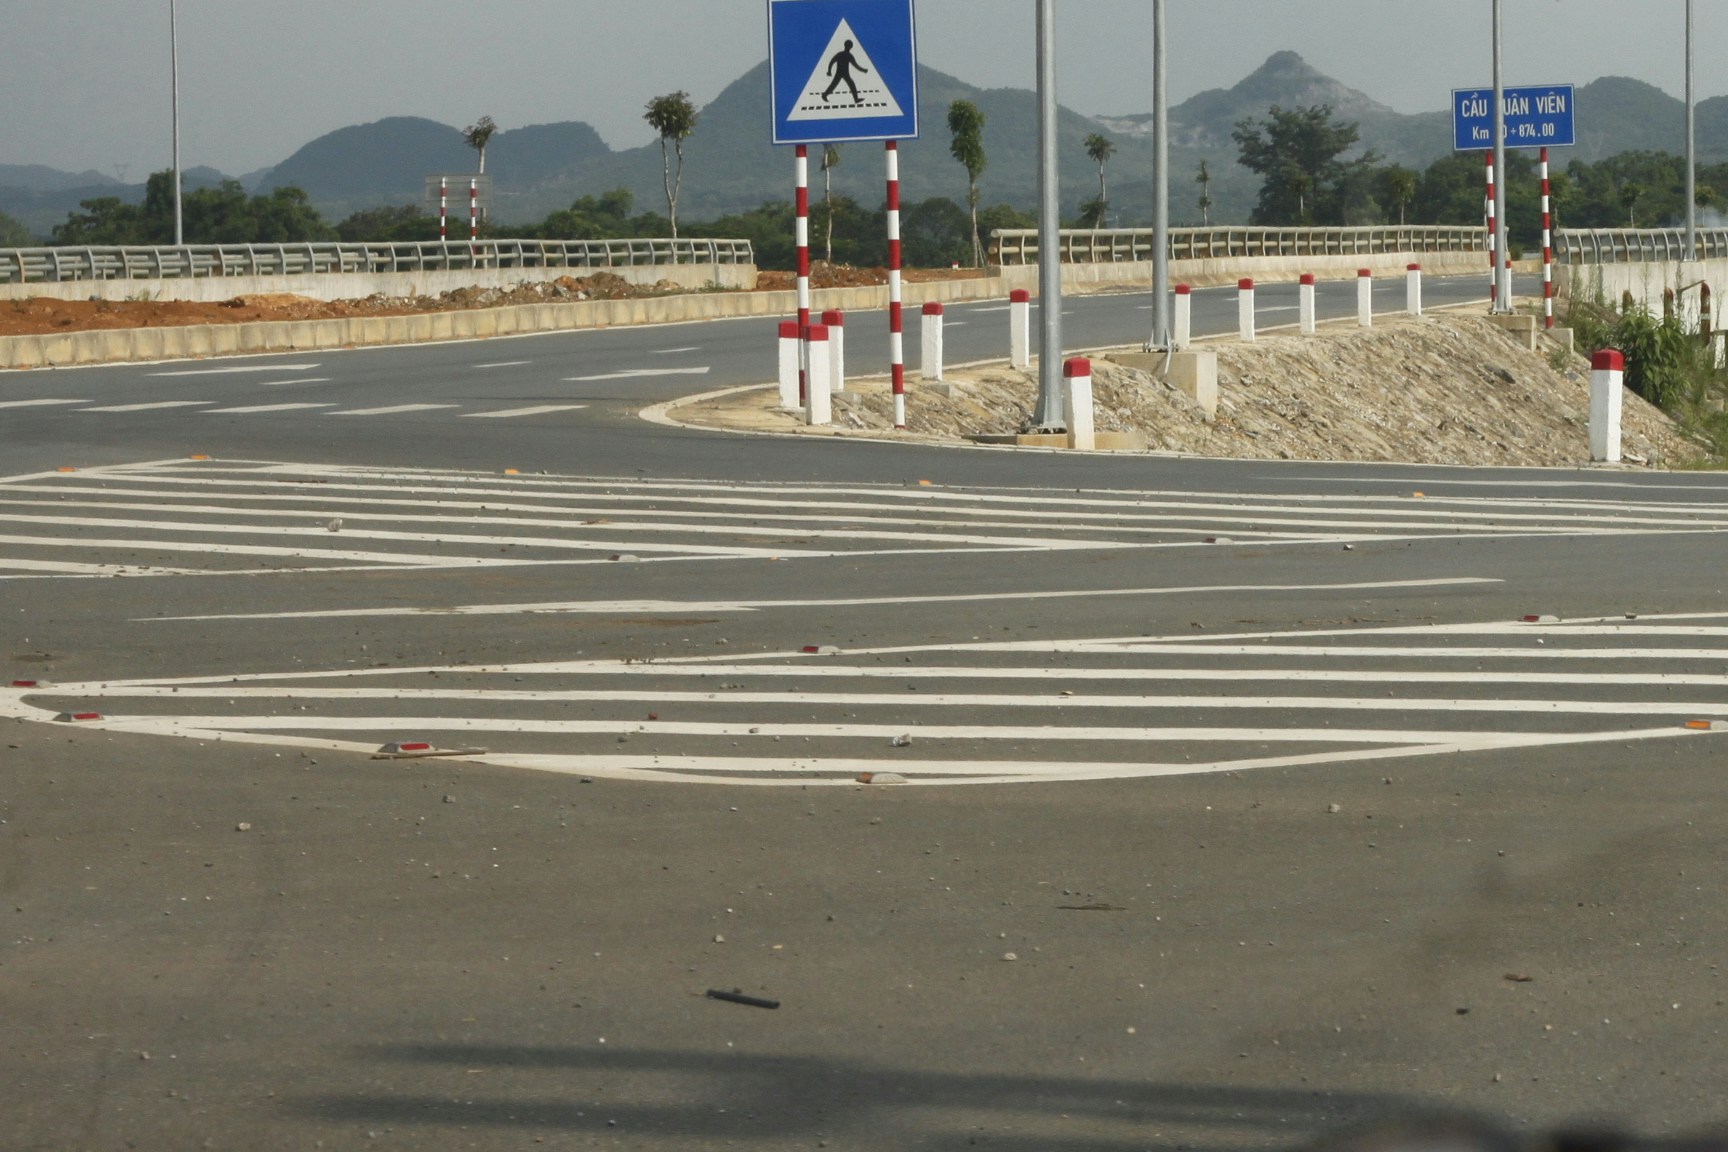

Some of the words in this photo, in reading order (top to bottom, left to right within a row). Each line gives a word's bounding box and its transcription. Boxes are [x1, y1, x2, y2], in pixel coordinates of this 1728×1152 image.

[1462, 92, 1487, 117] CẦU
[1502, 93, 1529, 116] UÂN
[1535, 91, 1565, 114] VIÊN
[1472, 126, 1489, 140] Km
